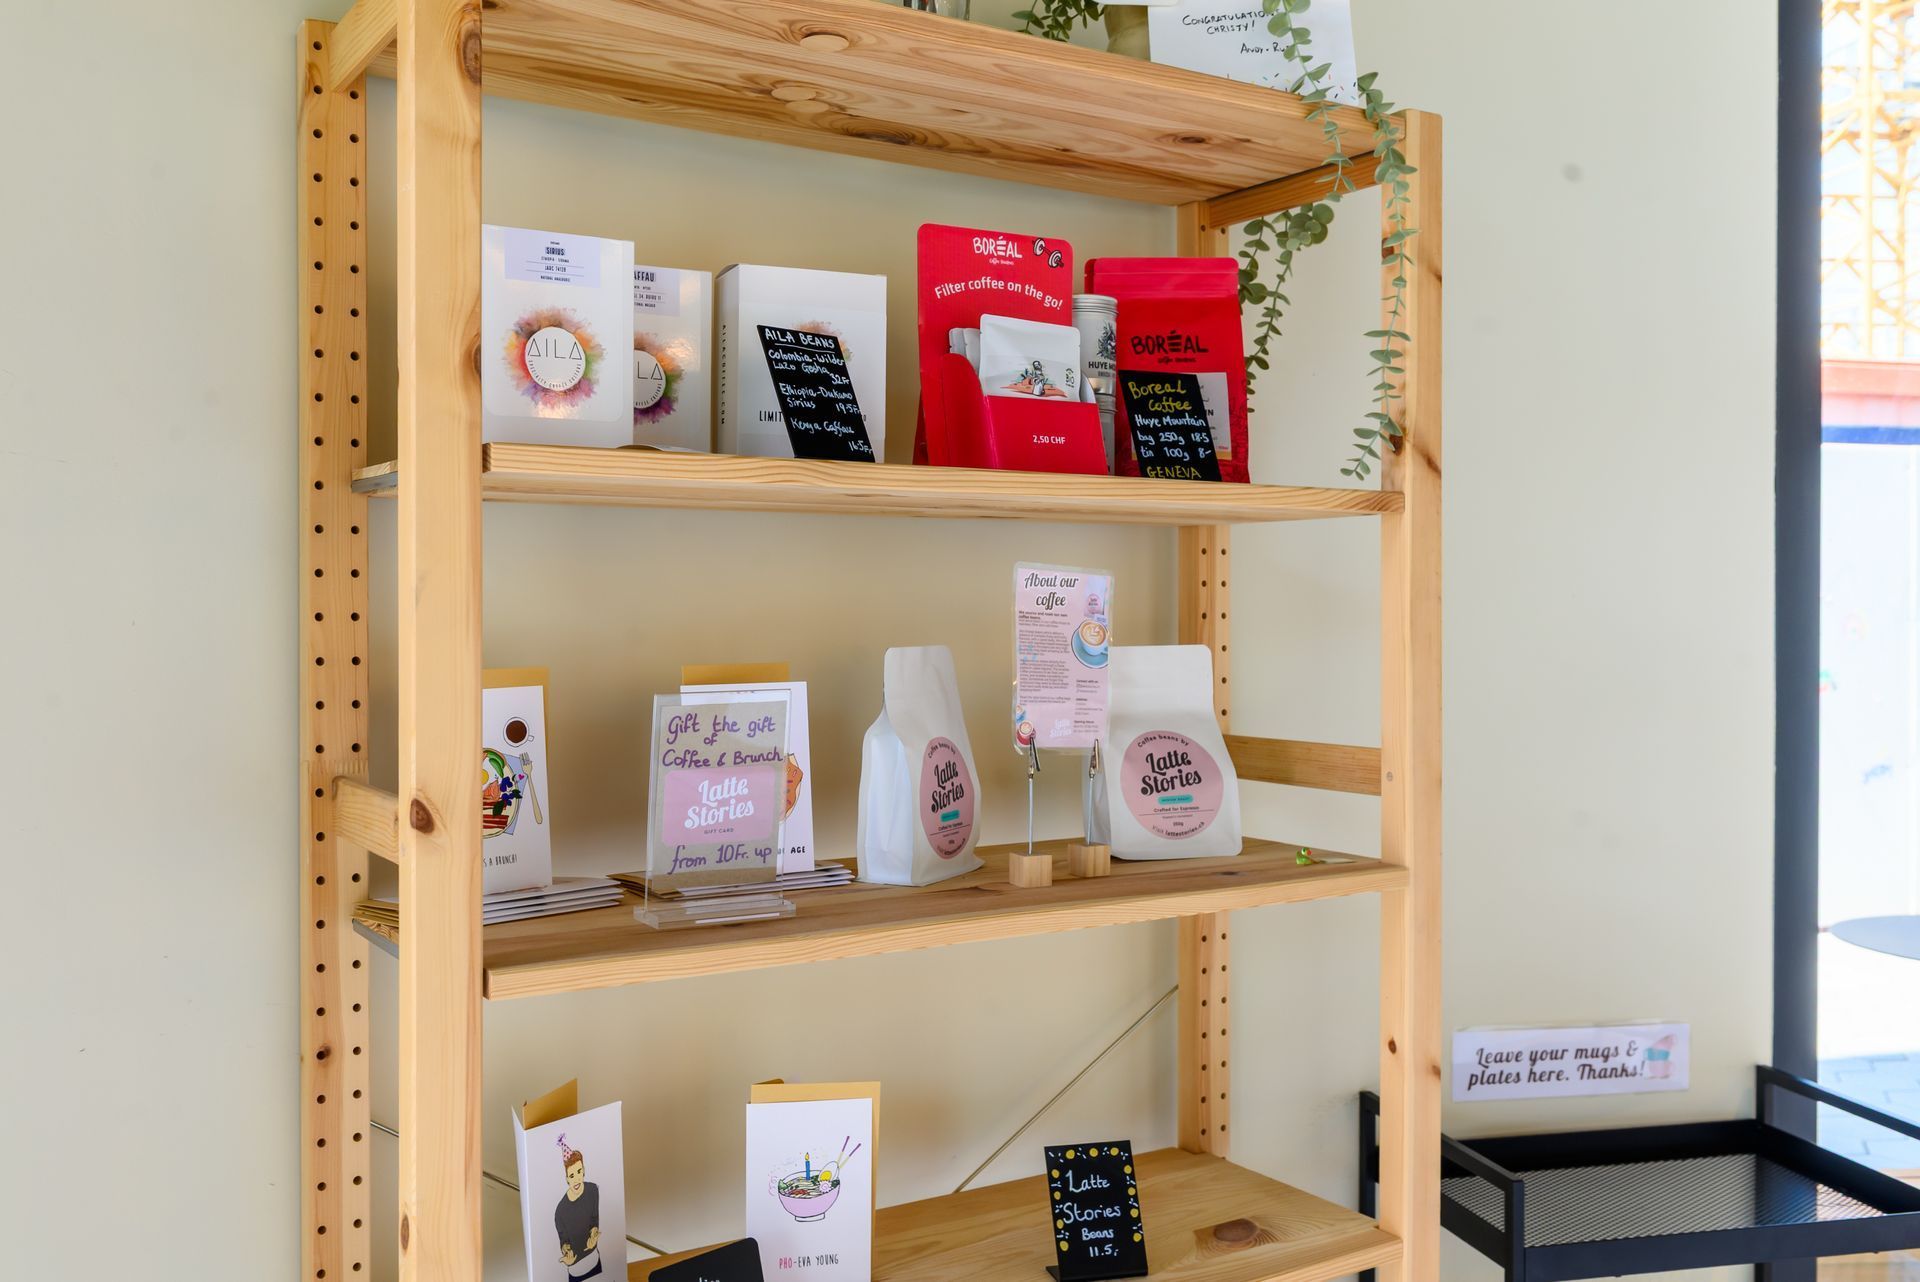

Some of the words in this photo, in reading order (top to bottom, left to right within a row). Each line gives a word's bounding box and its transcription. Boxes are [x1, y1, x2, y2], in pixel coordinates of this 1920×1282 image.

[1206, 20, 1255, 35] CHRISTY!
[546, 247, 565, 256] SIRIUS
[972, 236, 1023, 259] BORÉAL
[934, 280, 965, 299] Filter
[968, 277, 1004, 290] coffee
[1007, 282, 1021, 293] on
[1024, 284, 1042, 300] the
[1043, 294, 1063, 310] go!
[765, 328, 795, 344] AILA
[799, 332, 835, 349] BEANS
[1131, 330, 1209, 355] BORÉAL
[527, 338, 583, 361] AILA
[1088, 361, 1107, 370] HUYE
[1128, 380, 1187, 400] Boreal
[787, 398, 816, 408] Sirius
[790, 418, 821, 434] Kenya
[1134, 414, 1161, 429] Huye
[1163, 412, 1206, 427] Mountain
[1050, 436, 1066, 445] CHF
[1137, 430, 1155, 446] bag
[1159, 431, 1185, 445] 250g
[1140, 446, 1154, 459] tin
[1164, 447, 1189, 461] 100g
[1147, 466, 1201, 480] GENEVA
[1024, 573, 1058, 589] About
[1059, 577, 1079, 588] our
[1036, 591, 1066, 610] coffee
[667, 713, 700, 744] Gift
[712, 714, 740, 733] the
[747, 716, 776, 737] gift
[704, 732, 718, 746] of
[1137, 735, 1157, 748] Coffee
[1180, 738, 1189, 746] by
[662, 748, 711, 768] Coffee
[733, 746, 784, 765] Brunch
[1145, 750, 1192, 776] Latte
[934, 760, 958, 790] Latte
[1141, 769, 1202, 796] Stories
[698, 776, 749, 807] Latte
[931, 782, 964, 813] Stories
[684, 797, 754, 829] Stories
[495, 854, 518, 866] BRUNCH!
[667, 844, 707, 875] from
[755, 846, 773, 864] up
[790, 846, 806, 854] AGE
[1475, 1047, 1523, 1069] Leave
[1529, 1048, 1569, 1067] your
[1574, 1044, 1620, 1063] mugs
[1626, 1040, 1638, 1057] &
[1468, 1067, 1521, 1091] plates
[1527, 1067, 1569, 1083] here.
[1576, 1060, 1646, 1081] Thanks!
[1065, 1170, 1110, 1193] Latte
[1063, 1202, 1121, 1224] Stories
[1081, 1228, 1114, 1241] Beans
[779, 1256, 811, 1269] PHO-EVA
[815, 1254, 839, 1266] YOUNG
